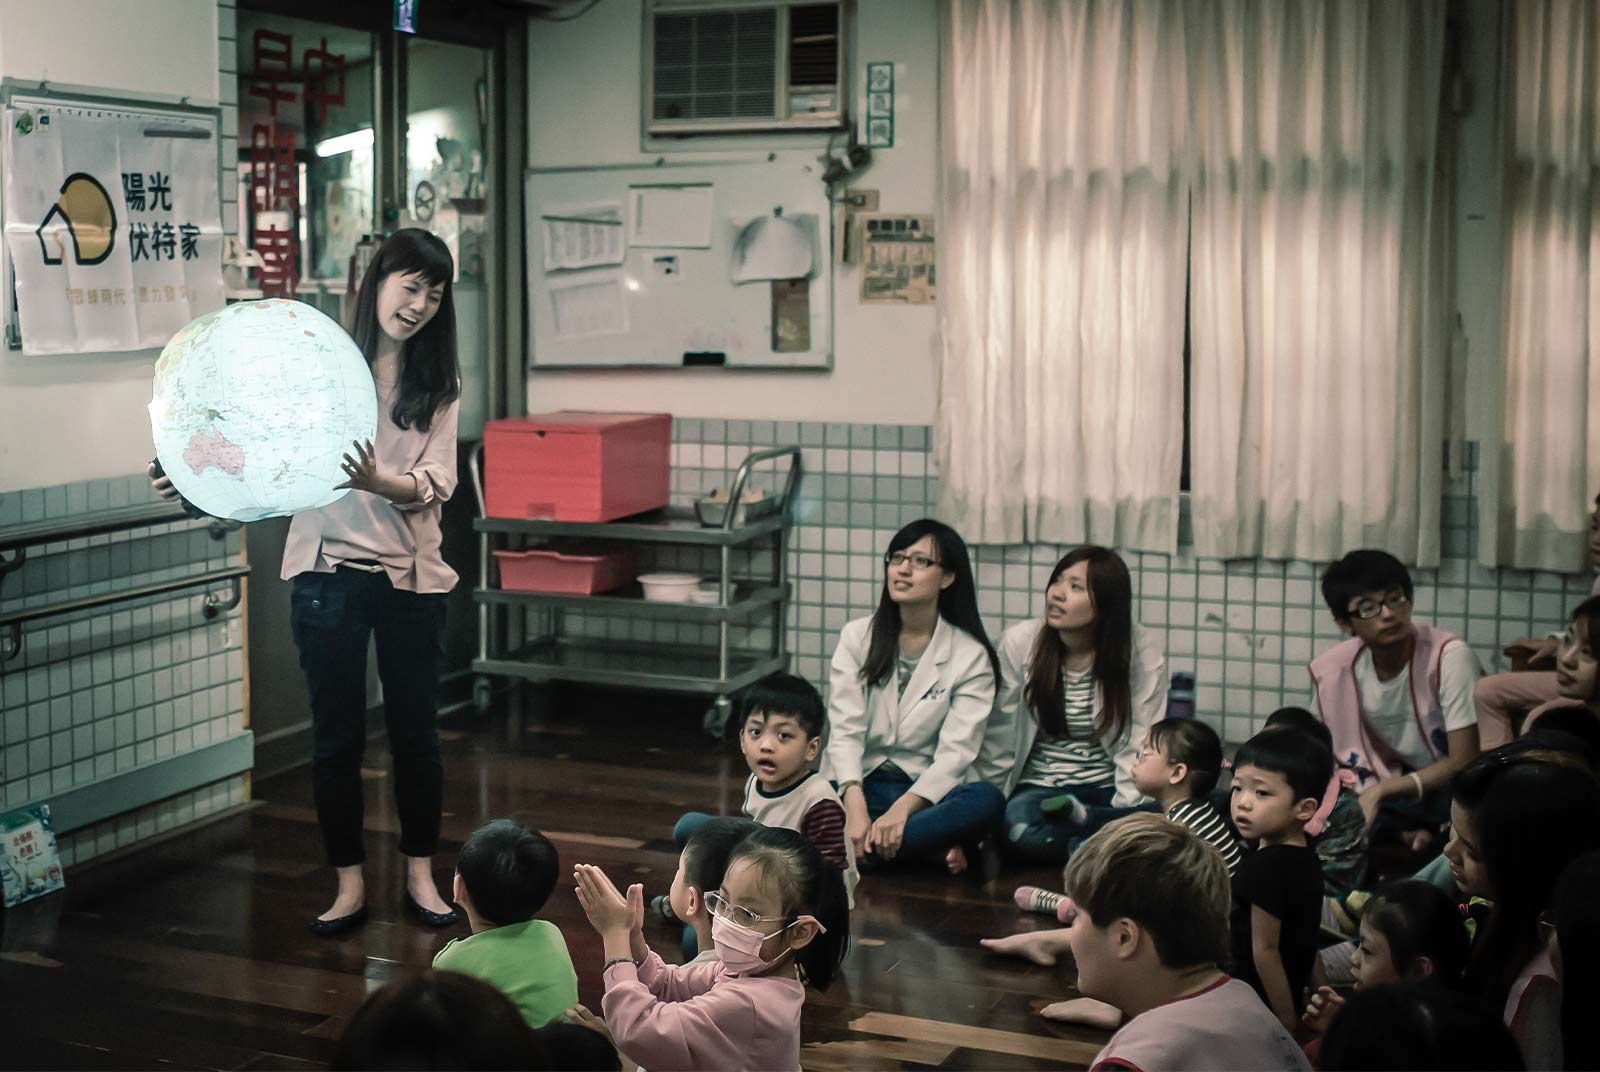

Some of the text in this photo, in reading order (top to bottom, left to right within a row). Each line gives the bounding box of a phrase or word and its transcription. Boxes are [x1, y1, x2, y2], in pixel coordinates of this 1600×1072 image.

[121, 171, 172, 212] 陽光
[129, 221, 201, 262] 伏特家
